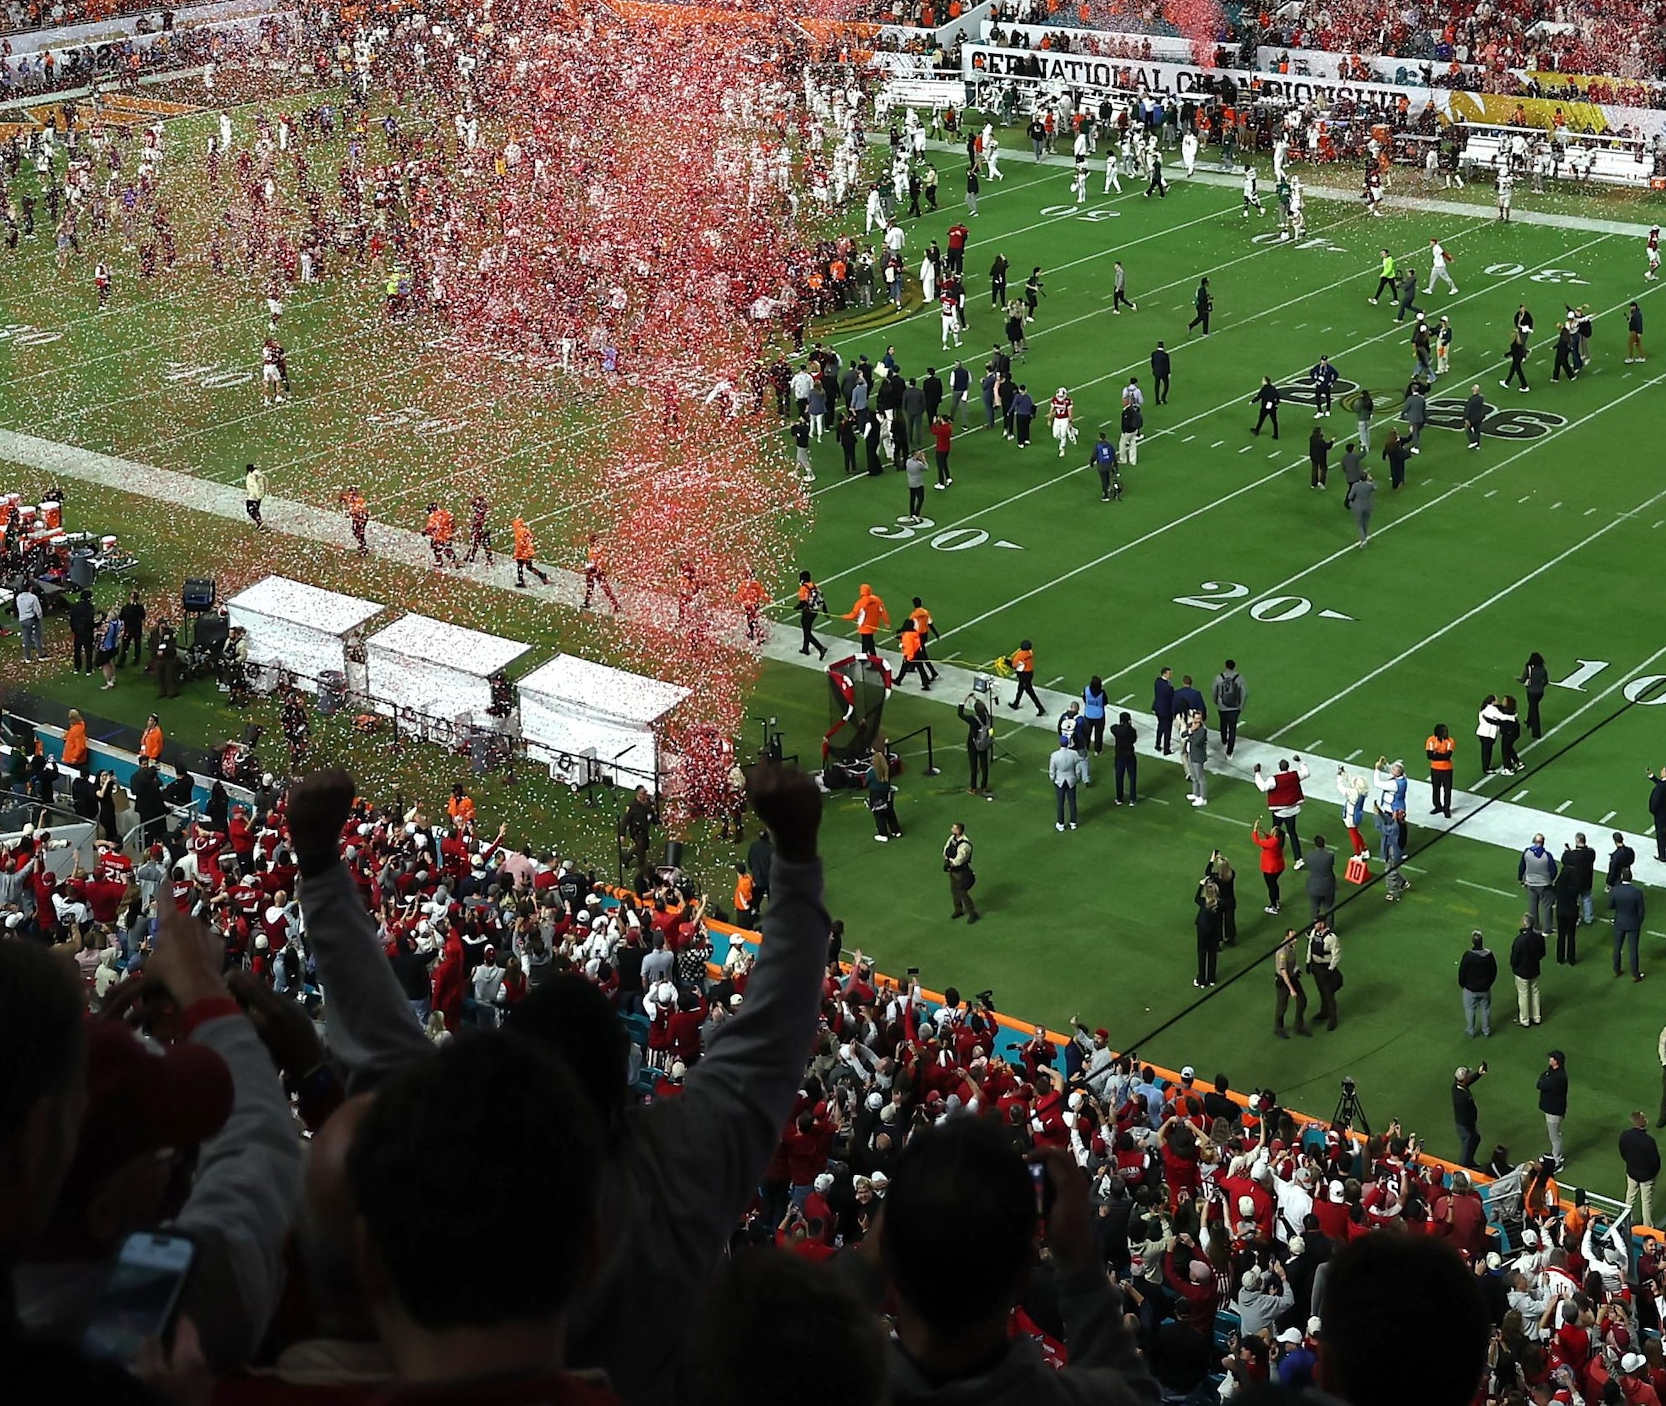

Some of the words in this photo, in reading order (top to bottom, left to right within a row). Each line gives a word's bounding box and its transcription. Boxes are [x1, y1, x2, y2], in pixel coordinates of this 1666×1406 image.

[868, 514, 992, 552] 30
[1172, 580, 1314, 623] 20
[1348, 861, 1363, 881] 10
